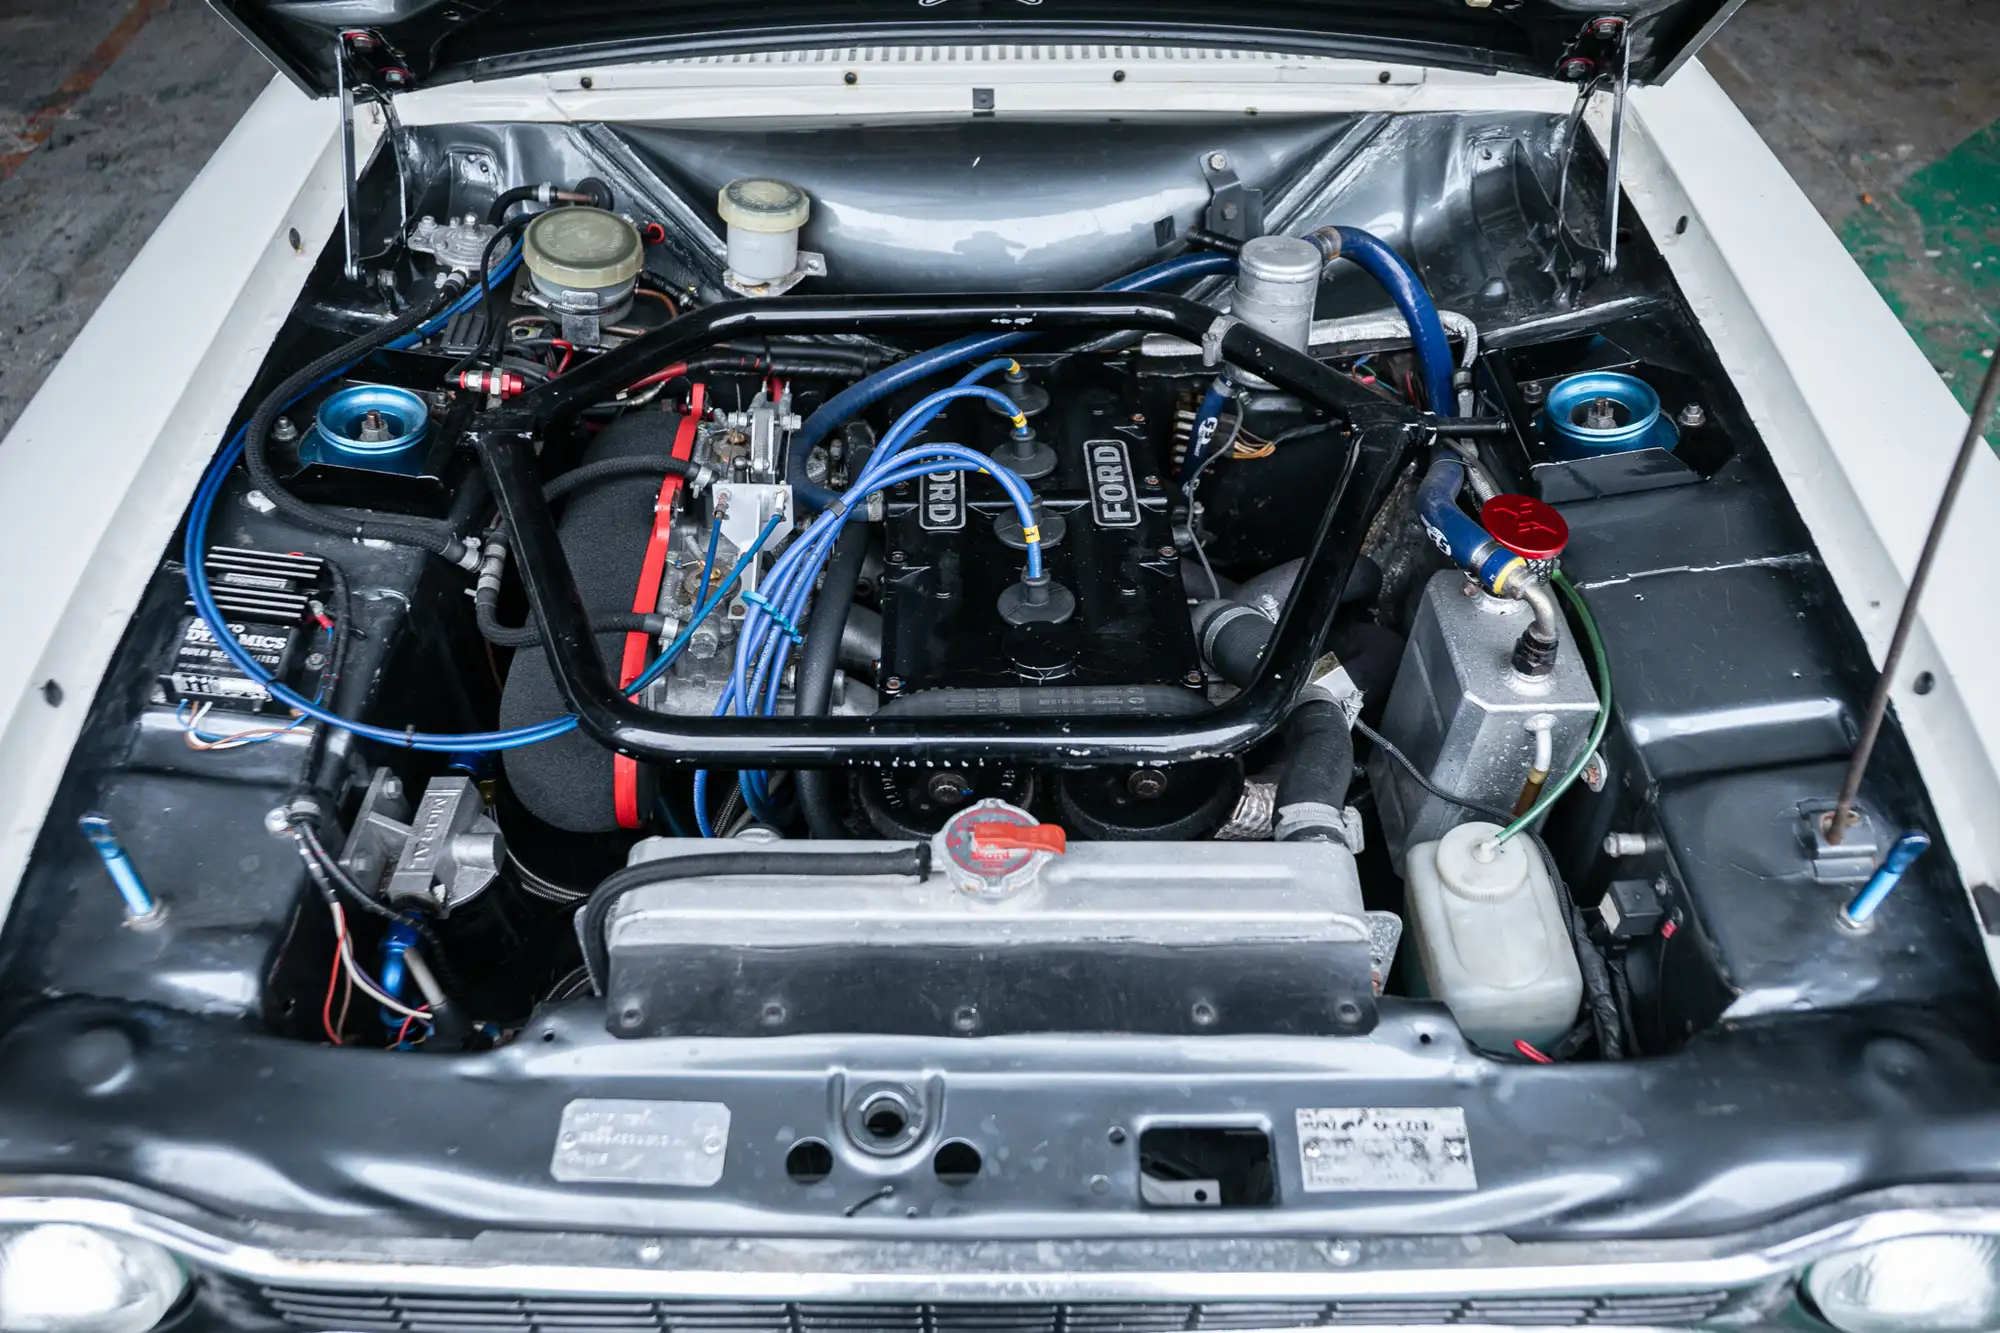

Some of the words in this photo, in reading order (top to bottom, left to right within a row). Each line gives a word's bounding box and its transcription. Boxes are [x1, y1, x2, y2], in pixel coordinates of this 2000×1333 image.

[928, 455, 957, 522] ORD
[1093, 445, 1132, 520] FORD
[184, 629, 288, 649] DYMICS
